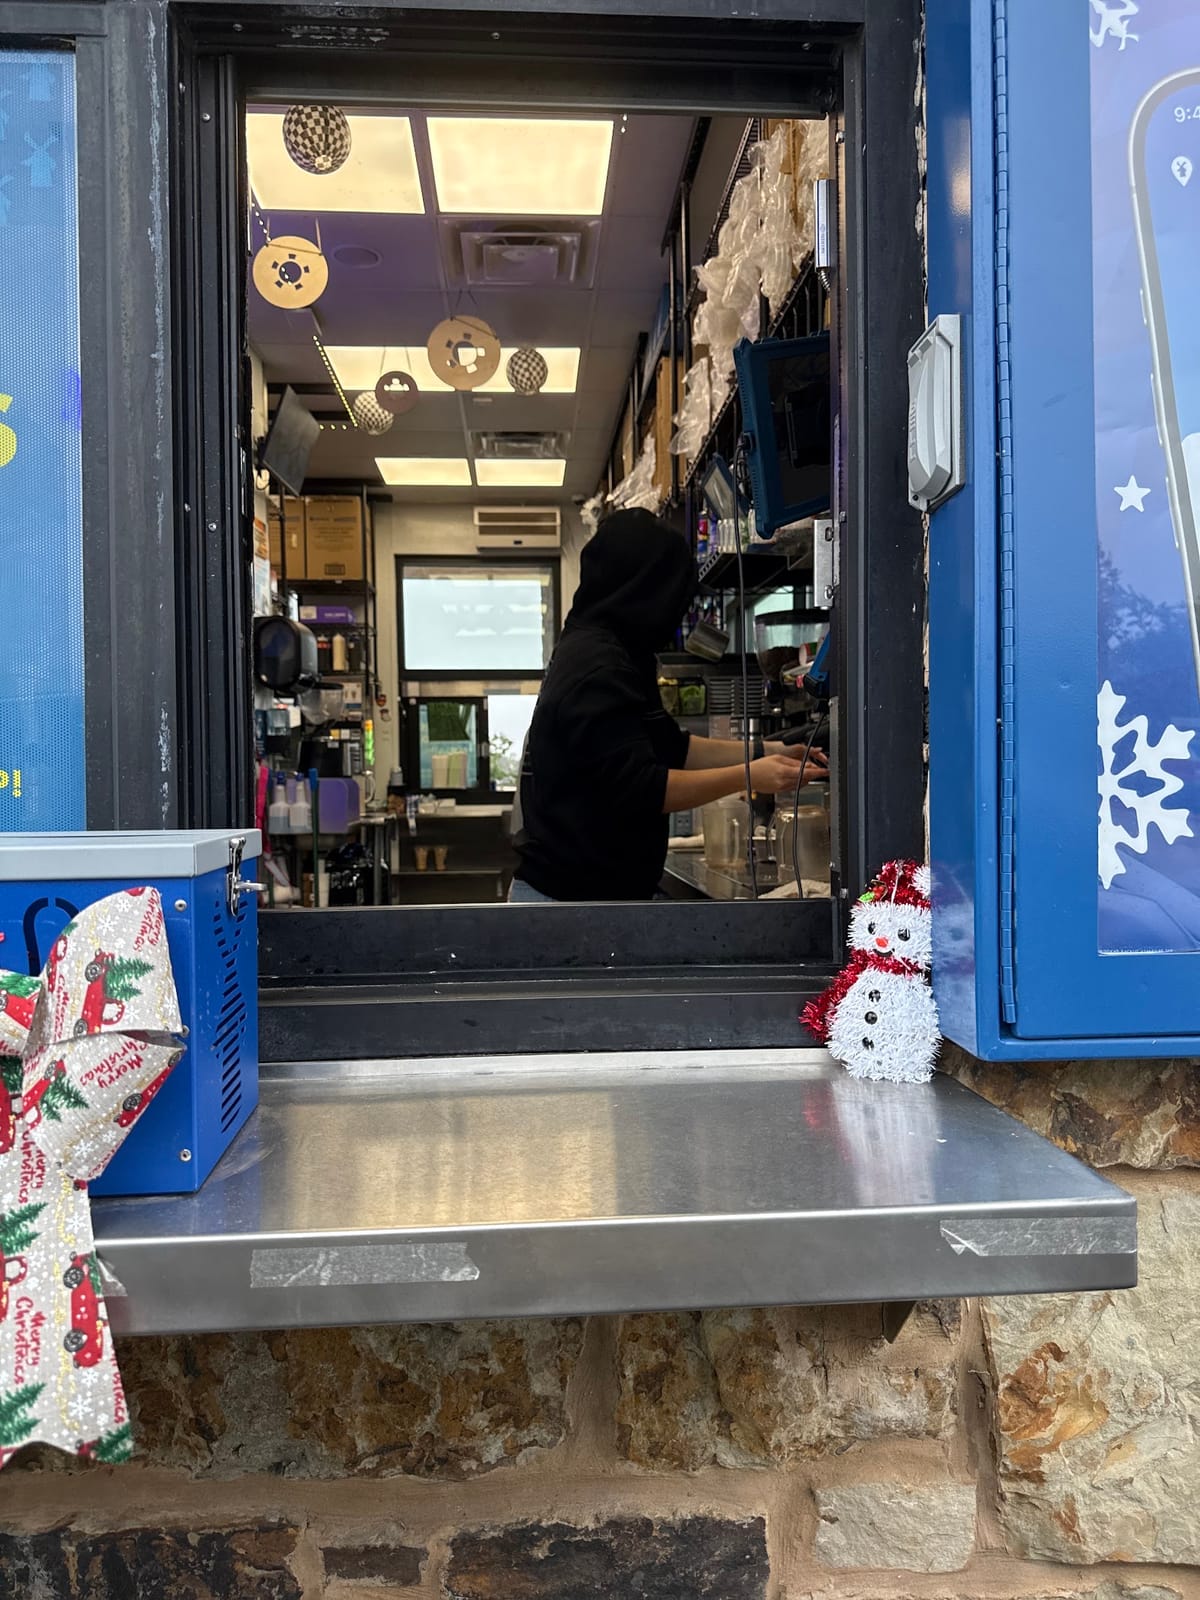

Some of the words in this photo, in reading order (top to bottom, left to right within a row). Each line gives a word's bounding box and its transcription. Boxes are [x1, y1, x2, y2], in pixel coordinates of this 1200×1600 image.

[97, 1053, 143, 1088] Merry
[14, 1296, 34, 1385] Christmas
[26, 1311, 47, 1367] Merry
